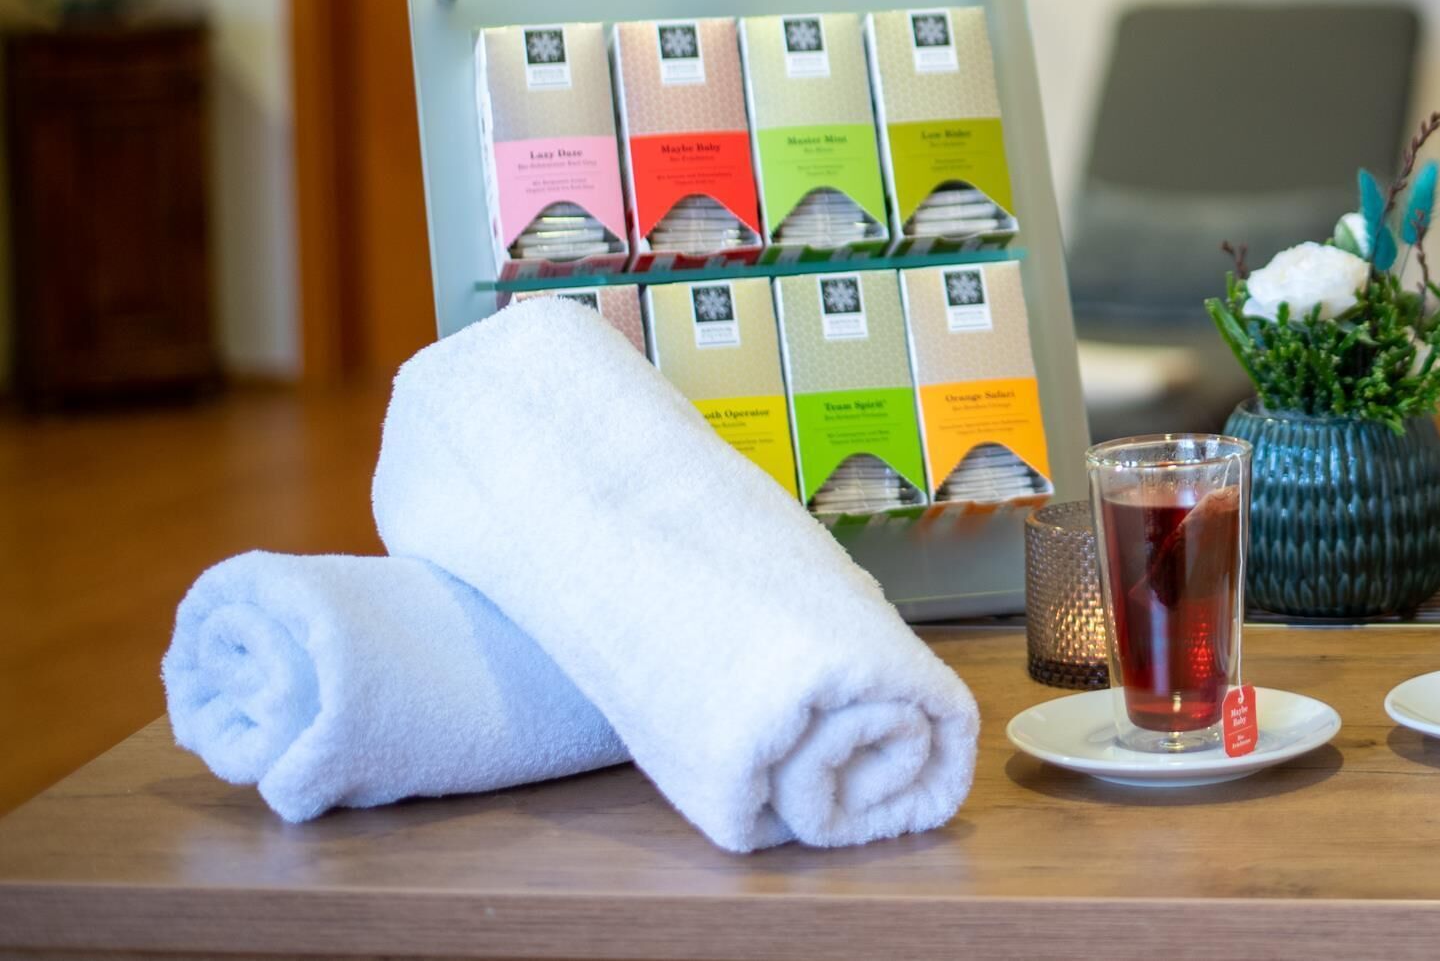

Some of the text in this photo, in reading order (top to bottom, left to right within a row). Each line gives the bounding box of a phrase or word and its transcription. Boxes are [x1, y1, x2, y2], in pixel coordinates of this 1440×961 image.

[661, 142, 720, 154] Maybe Baby
[530, 149, 583, 160] Lazy Daze
[945, 389, 1015, 403] Orange Safari
[824, 402, 852, 411] Team
[724, 409, 769, 419] Operator
